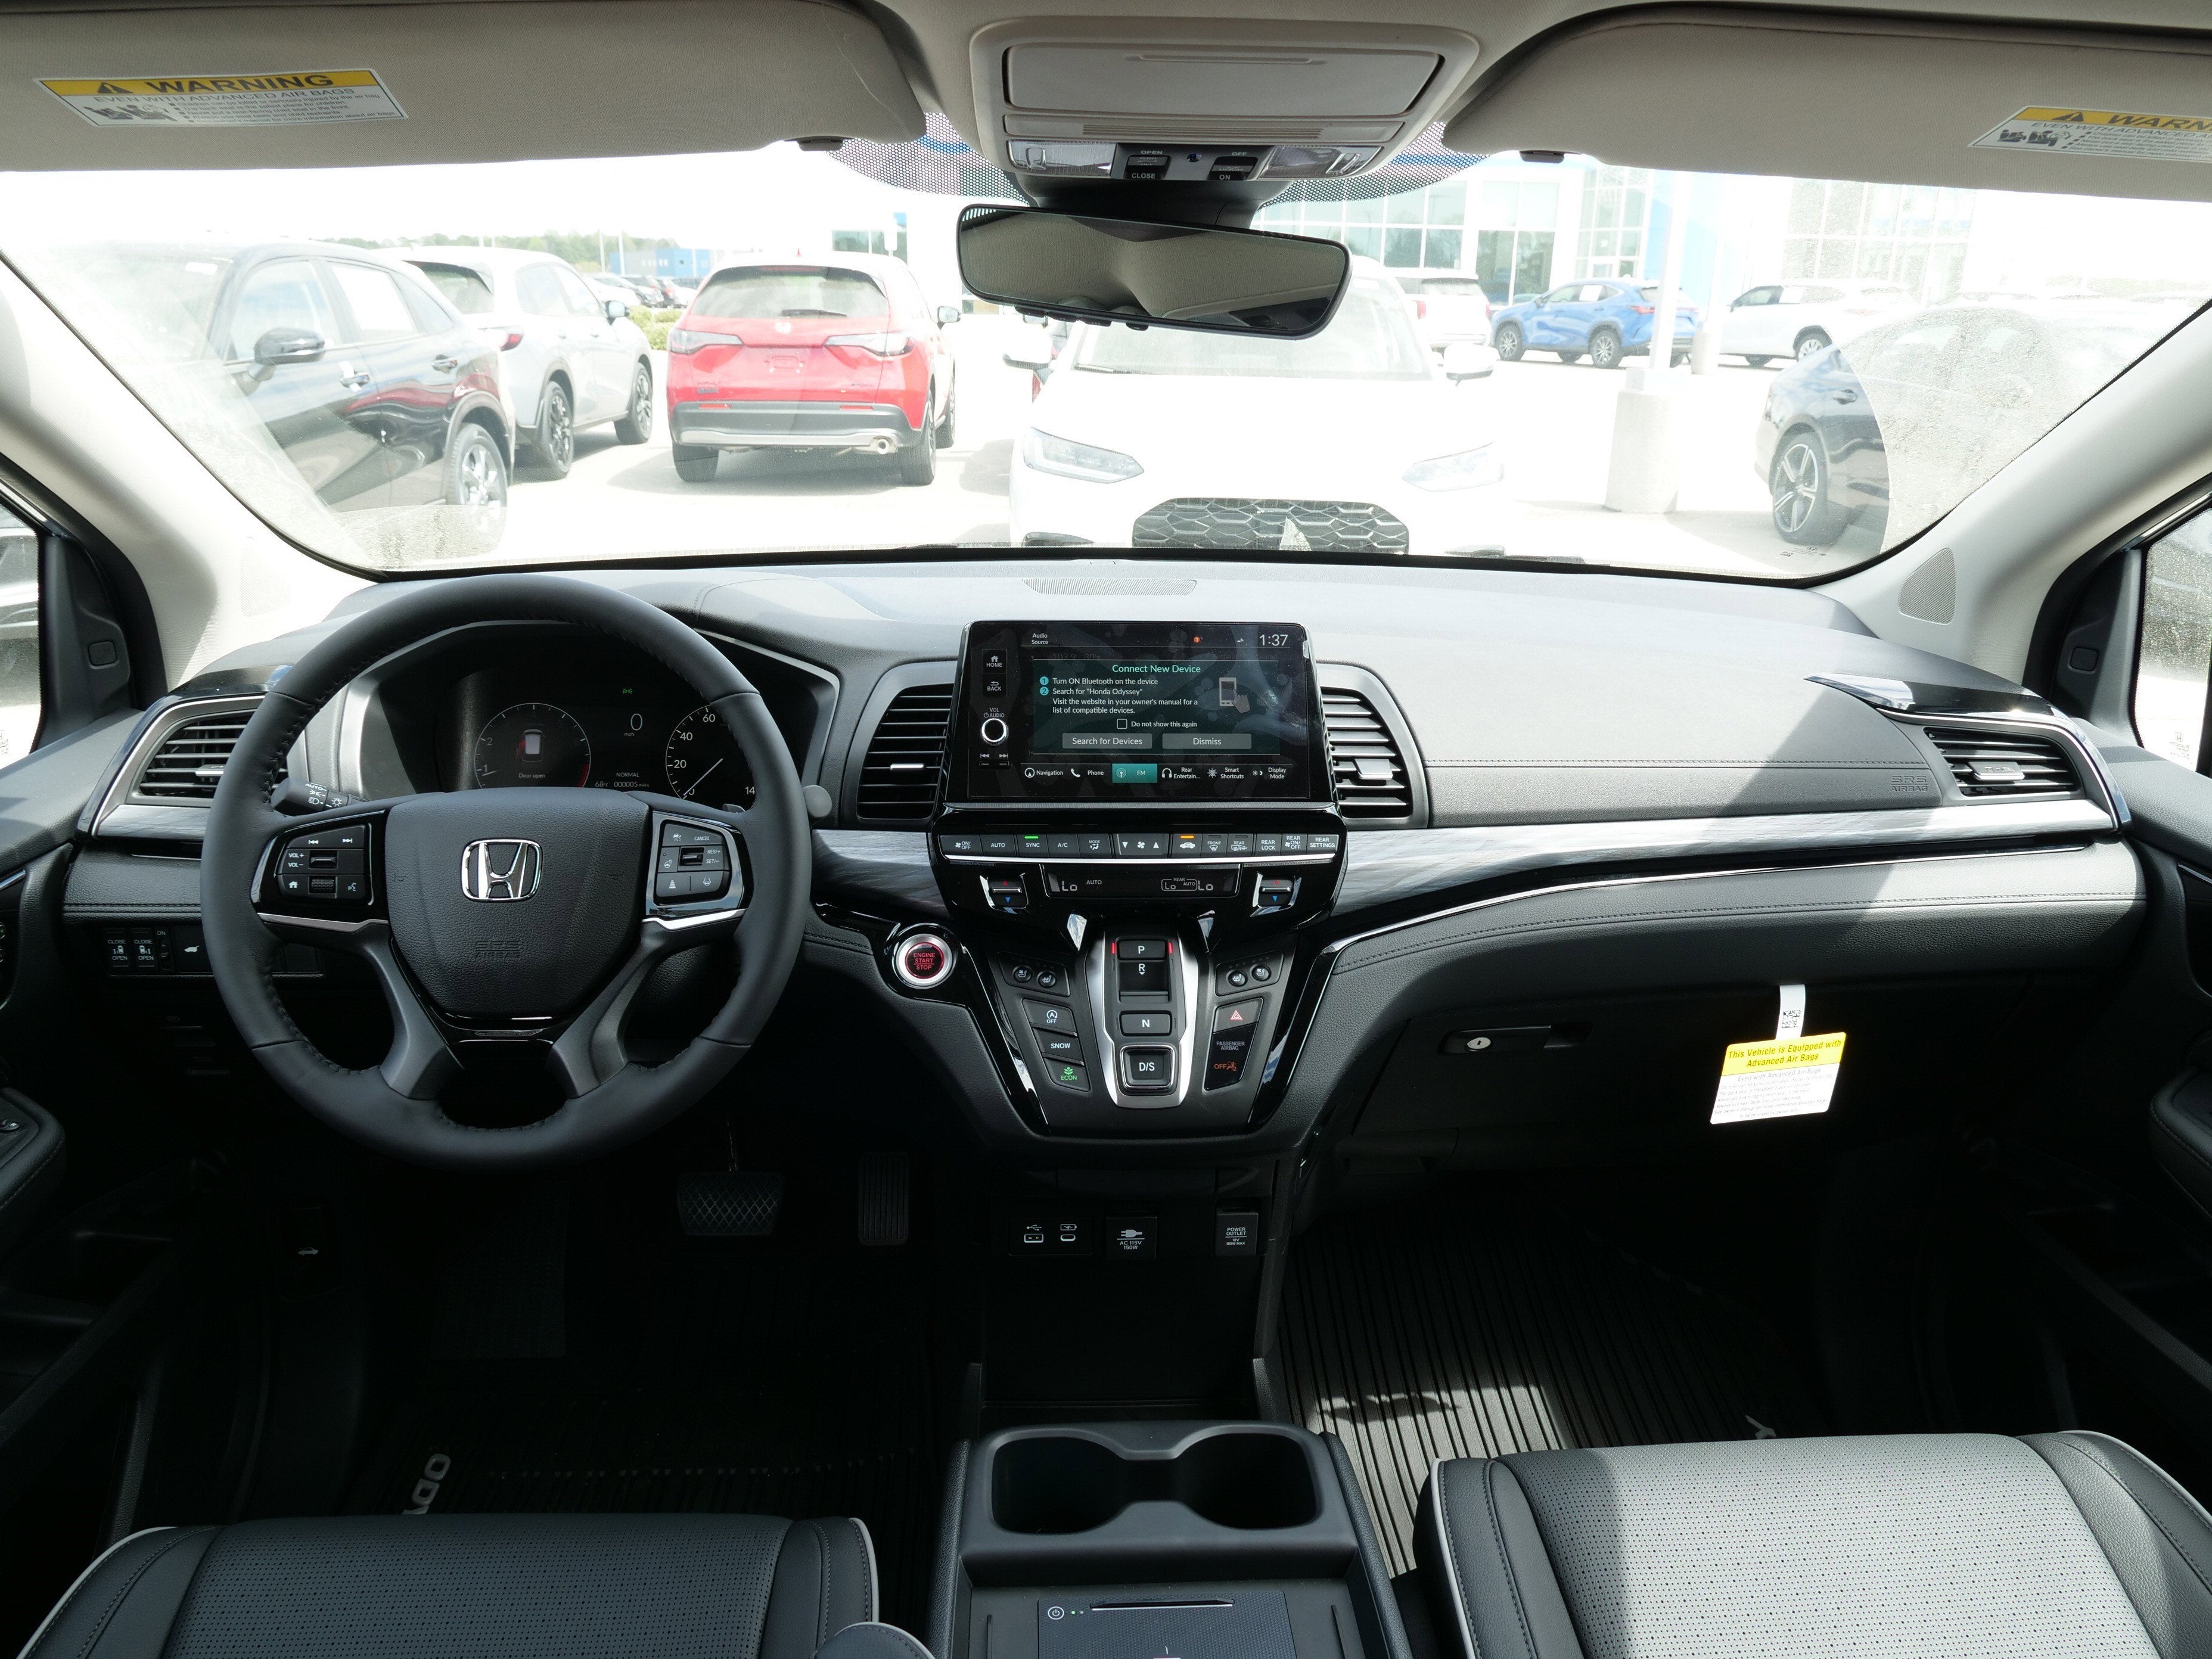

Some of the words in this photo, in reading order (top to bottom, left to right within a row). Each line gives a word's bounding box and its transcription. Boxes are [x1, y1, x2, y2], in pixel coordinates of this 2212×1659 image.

[145, 74, 333, 93] WARNING
[190, 92, 277, 101] ADVANCED
[310, 88, 355, 96] BAGS
[2117, 127, 2194, 138] ADVANCED
[1259, 634, 1288, 646] 1:37
[1112, 664, 1148, 673] Connect
[1150, 664, 1170, 673] New
[1172, 664, 1201, 673] Device
[630, 713, 643, 731] 0
[703, 713, 716, 722] 60
[487, 737, 493, 746] 2
[679, 732, 693, 741] 40
[483, 764, 487, 773] 1
[673, 759, 687, 769] 20
[1138, 945, 1145, 955] P
[1138, 963, 1145, 972] R
[1142, 1019, 1150, 1028] N
[1728, 1051, 1745, 1059] This
[1747, 1047, 1776, 1057] Vehicle
[1788, 1043, 1823, 1053] Equipped
[1825, 1039, 1841, 1048] with
[1746, 1057, 1785, 1067] Advanced
[1800, 1053, 1819, 1062] Bags
[1139, 1062, 1155, 1071] D/S
